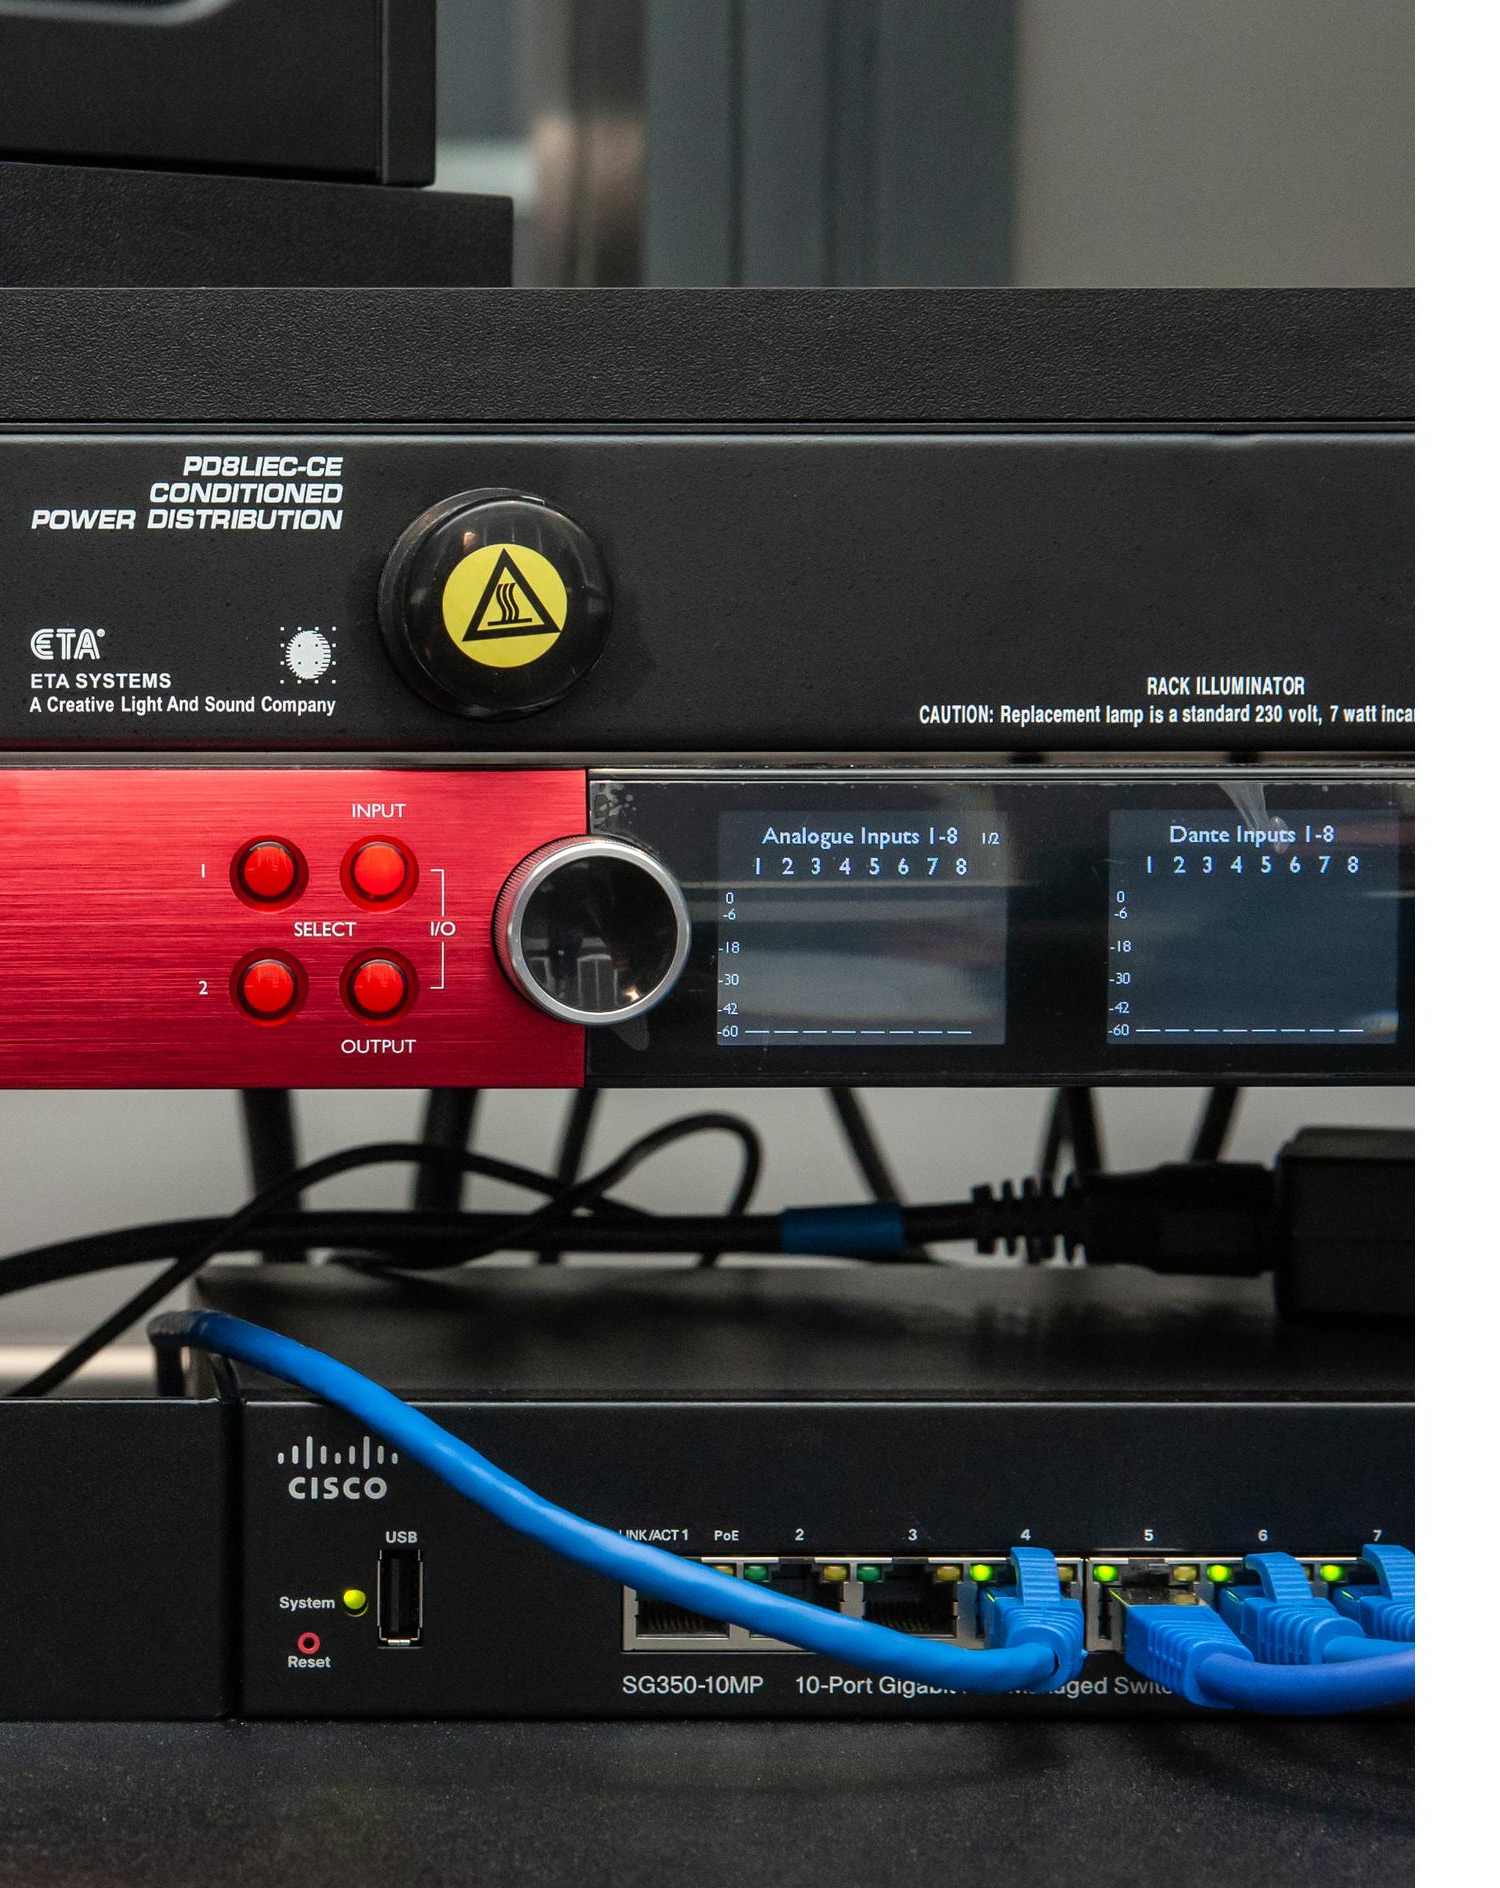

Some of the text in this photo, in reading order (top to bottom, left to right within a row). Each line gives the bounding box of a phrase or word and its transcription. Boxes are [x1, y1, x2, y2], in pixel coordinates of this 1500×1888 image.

[182, 455, 344, 477] PD8LIEC-CE
[149, 482, 344, 504] CONDITIONED
[31, 508, 344, 530] POWER DISTRIBUTION
[30, 672, 172, 689] ETA SYSTEMS
[1147, 675, 1305, 696] RACK ILLUMINATOR
[29, 695, 336, 717] A Creative Light And Sound Company
[919, 704, 994, 725] CAUTION:
[1000, 704, 1101, 728] Replacement
[1106, 705, 1144, 728] lamp
[1149, 705, 1164, 724] is
[1168, 708, 1178, 723] a
[1182, 703, 1250, 723] standard
[1255, 704, 1283, 723] 230
[1288, 703, 1323, 726] volt,
[1329, 705, 1339, 723] 7
[1343, 705, 1377, 723] watt
[352, 803, 407, 818] INPUT
[761, 826, 854, 850] Analogue
[861, 826, 920, 850] Inputs
[929, 826, 958, 845] 1-8
[1169, 824, 1334, 848] Dante Inputs 1-8
[781, 857, 795, 875] 2
[811, 857, 821, 875] 3
[838, 857, 851, 875] 4
[869, 857, 880, 875] 5
[897, 857, 909, 875] 6
[926, 857, 939, 876] 7
[955, 857, 967, 876] 8
[1173, 855, 1186, 874] 2
[1202, 855, 1212, 874] 3
[1230, 855, 1243, 874] 4
[1260, 855, 1272, 874] 5
[1289, 855, 1301, 873] 6
[1318, 855, 1331, 874] 7
[1347, 855, 1359, 874] 8
[725, 891, 734, 905] 0
[1116, 890, 1125, 903] 0
[722, 907, 736, 920] -6
[1113, 906, 1128, 919] -6
[294, 921, 357, 937] SELECT
[430, 921, 456, 937] I/O
[718, 941, 740, 954] -18
[1109, 940, 1132, 953] -18
[717, 973, 740, 986] -30
[1109, 972, 1131, 985] -30
[198, 980, 209, 995] 2
[717, 1002, 739, 1015] -42
[1108, 1001, 1130, 1014] -42
[716, 1025, 739, 1038] -60
[1108, 1023, 1130, 1036] -60
[340, 1039, 417, 1054] OUTPUT
[288, 1476, 388, 1500] CISCO
[385, 1530, 418, 1544] USB
[619, 1528, 679, 1541] INK/ACT
[714, 1529, 740, 1541] PoE
[795, 1528, 805, 1541] 2
[908, 1528, 918, 1541] 3
[1020, 1528, 1031, 1541] 4
[1144, 1528, 1154, 1542] 5
[1258, 1529, 1268, 1542] 6
[1373, 1529, 1382, 1542] 7
[279, 1596, 336, 1612] System
[287, 1655, 331, 1669] Reset
[622, 1675, 764, 1694] SG350-10MP
[795, 1675, 873, 1694] 10-Port
[879, 1676, 956, 1698] Giga
